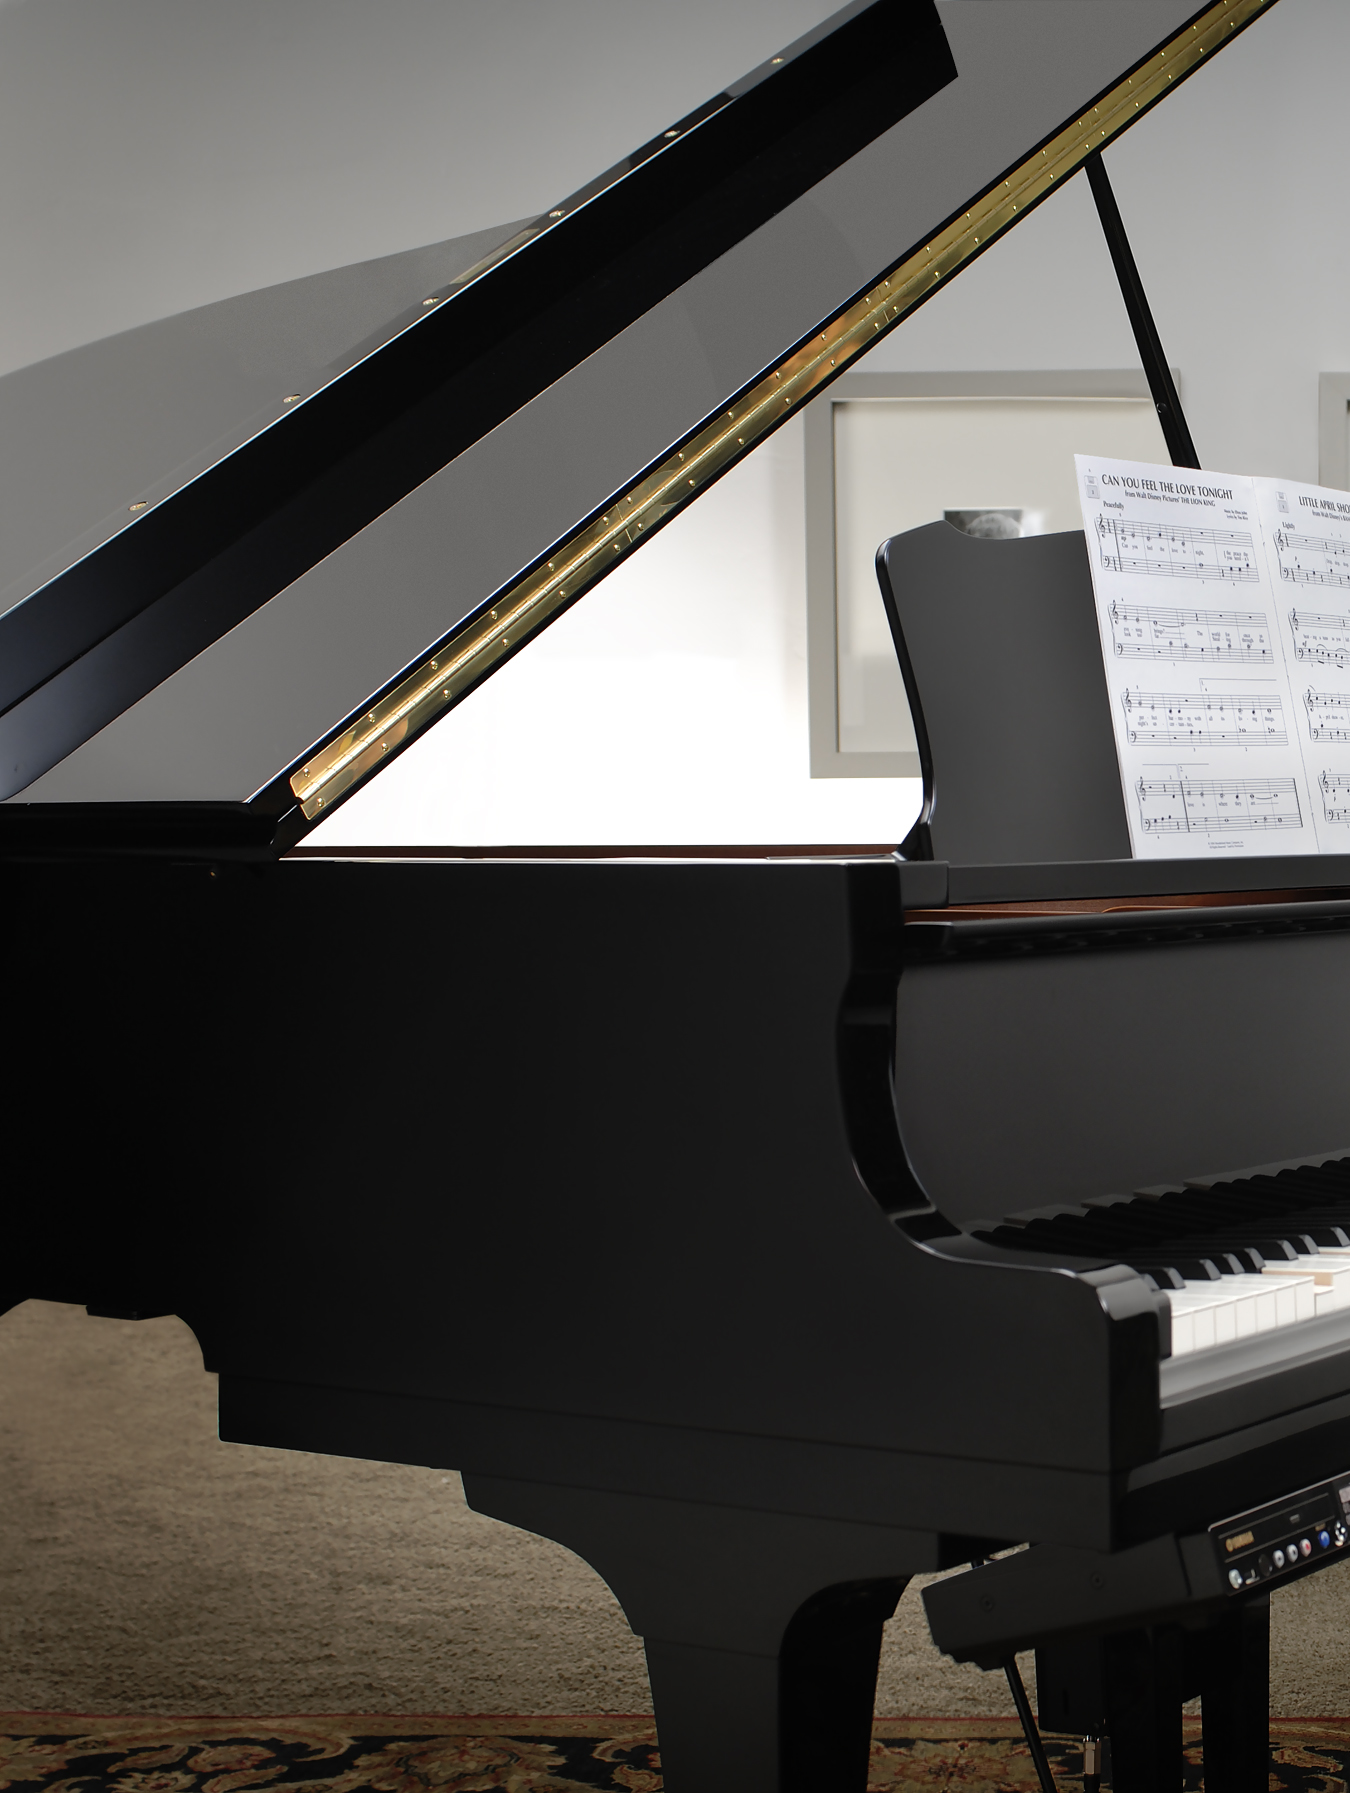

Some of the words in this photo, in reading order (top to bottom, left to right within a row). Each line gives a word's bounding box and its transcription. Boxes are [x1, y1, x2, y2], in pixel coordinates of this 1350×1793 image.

[1102, 474, 1120, 486] CAN
[1121, 476, 1139, 489] YOU
[1141, 479, 1158, 492] FEEL
[1159, 481, 1174, 493] THE
[1175, 483, 1195, 496] LOVE
[1197, 486, 1233, 500] TONIGHT
[1103, 500, 1125, 510] Peacefully
[1136, 491, 1147, 499] Walt
[1148, 493, 1161, 502] Disney
[1181, 496, 1190, 504] THE
[1203, 499, 1216, 507] KING
[1299, 496, 1318, 509] LITTLE
[1319, 499, 1336, 512] APRIL
[1282, 521, 1296, 530] Lightly
